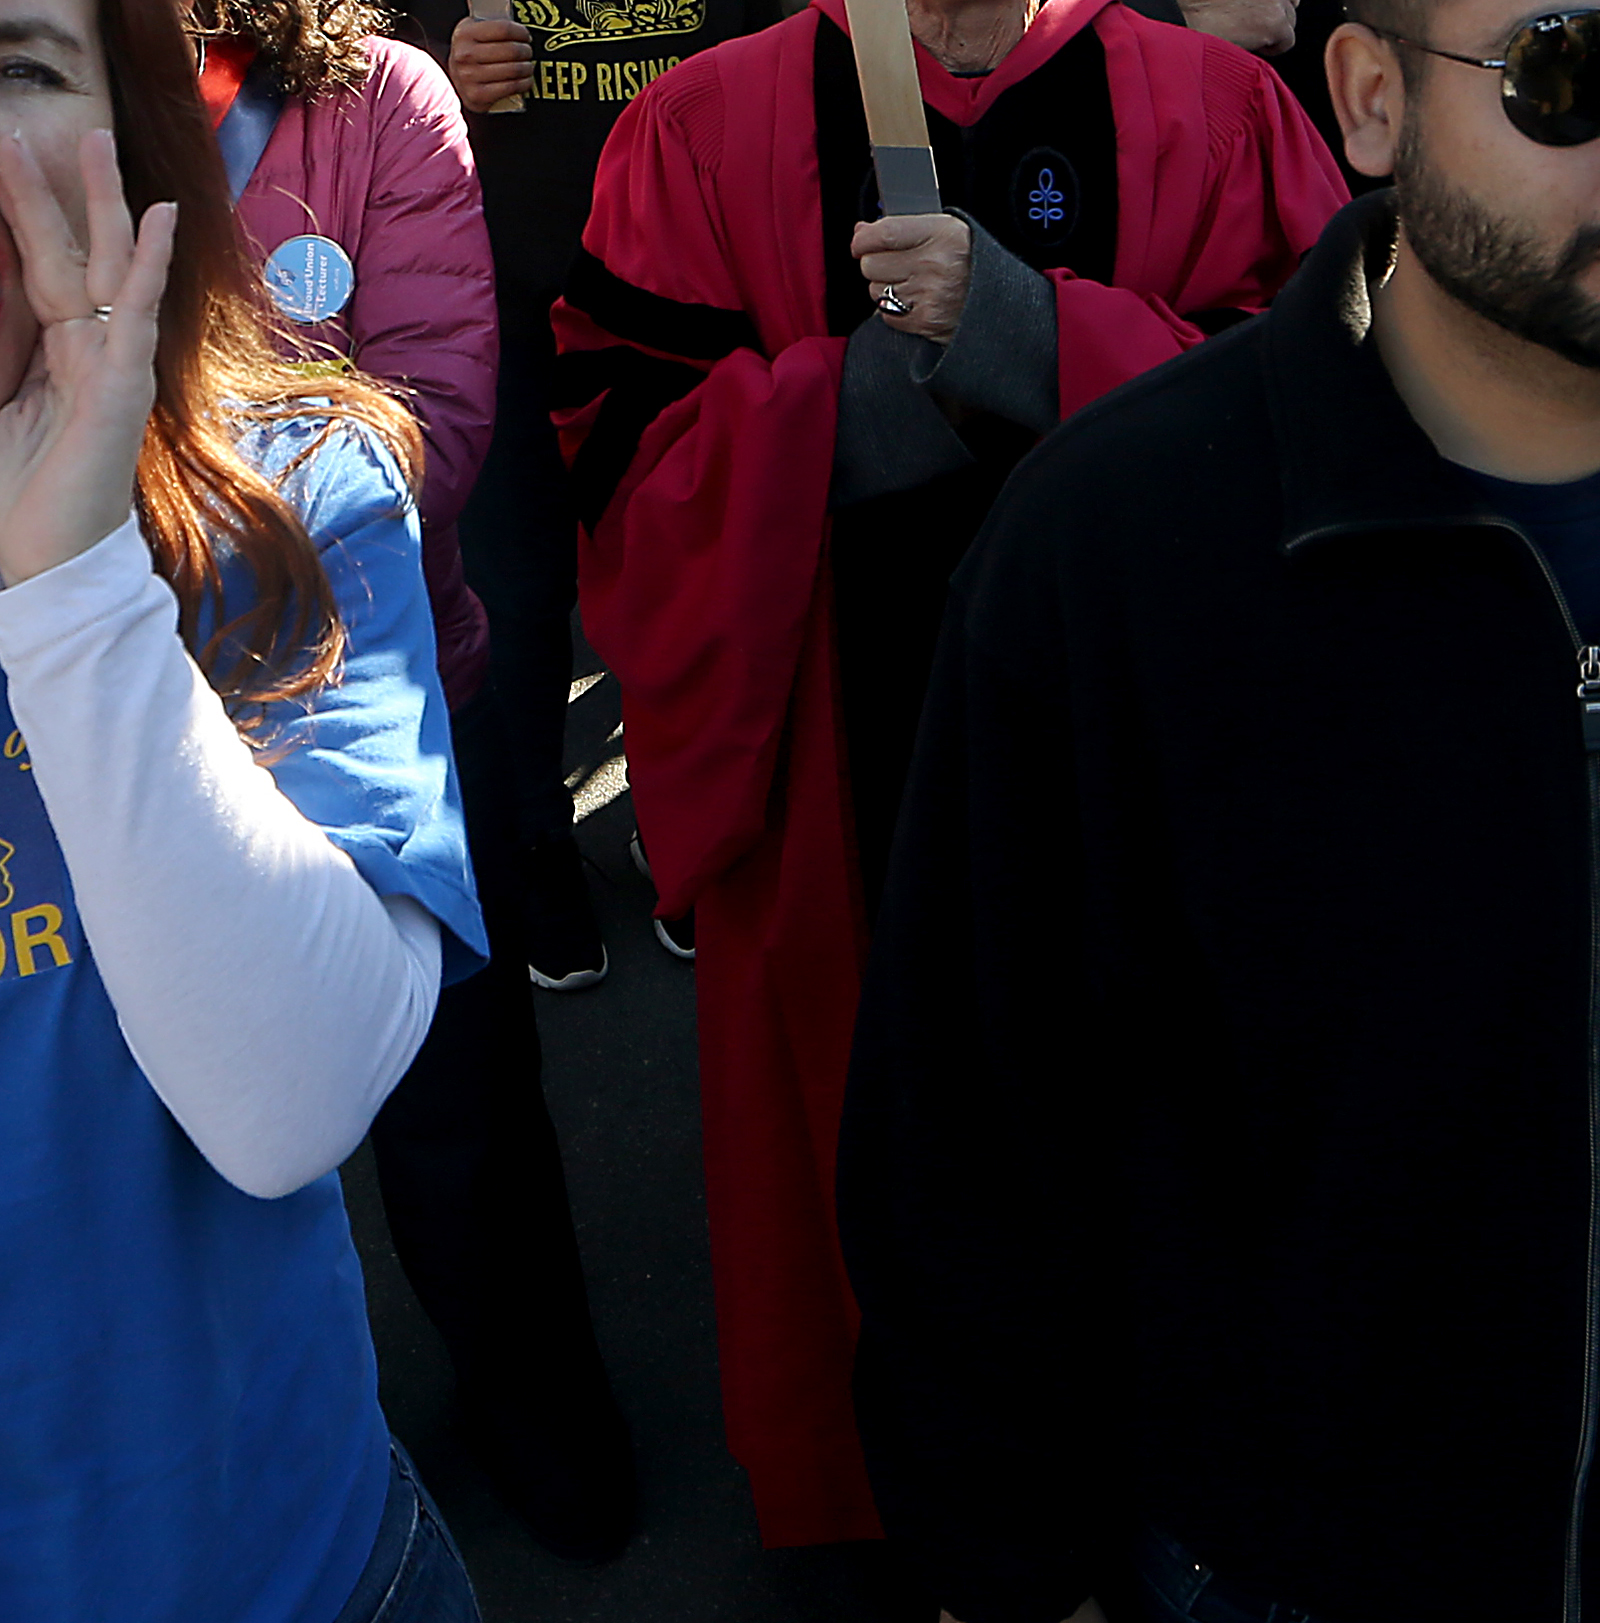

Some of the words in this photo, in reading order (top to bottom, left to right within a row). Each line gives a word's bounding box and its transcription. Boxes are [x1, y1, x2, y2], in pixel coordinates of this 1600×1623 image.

[522, 60, 588, 102] KEEP
[304, 242, 315, 278] Union
[317, 254, 329, 303] Lecturer
